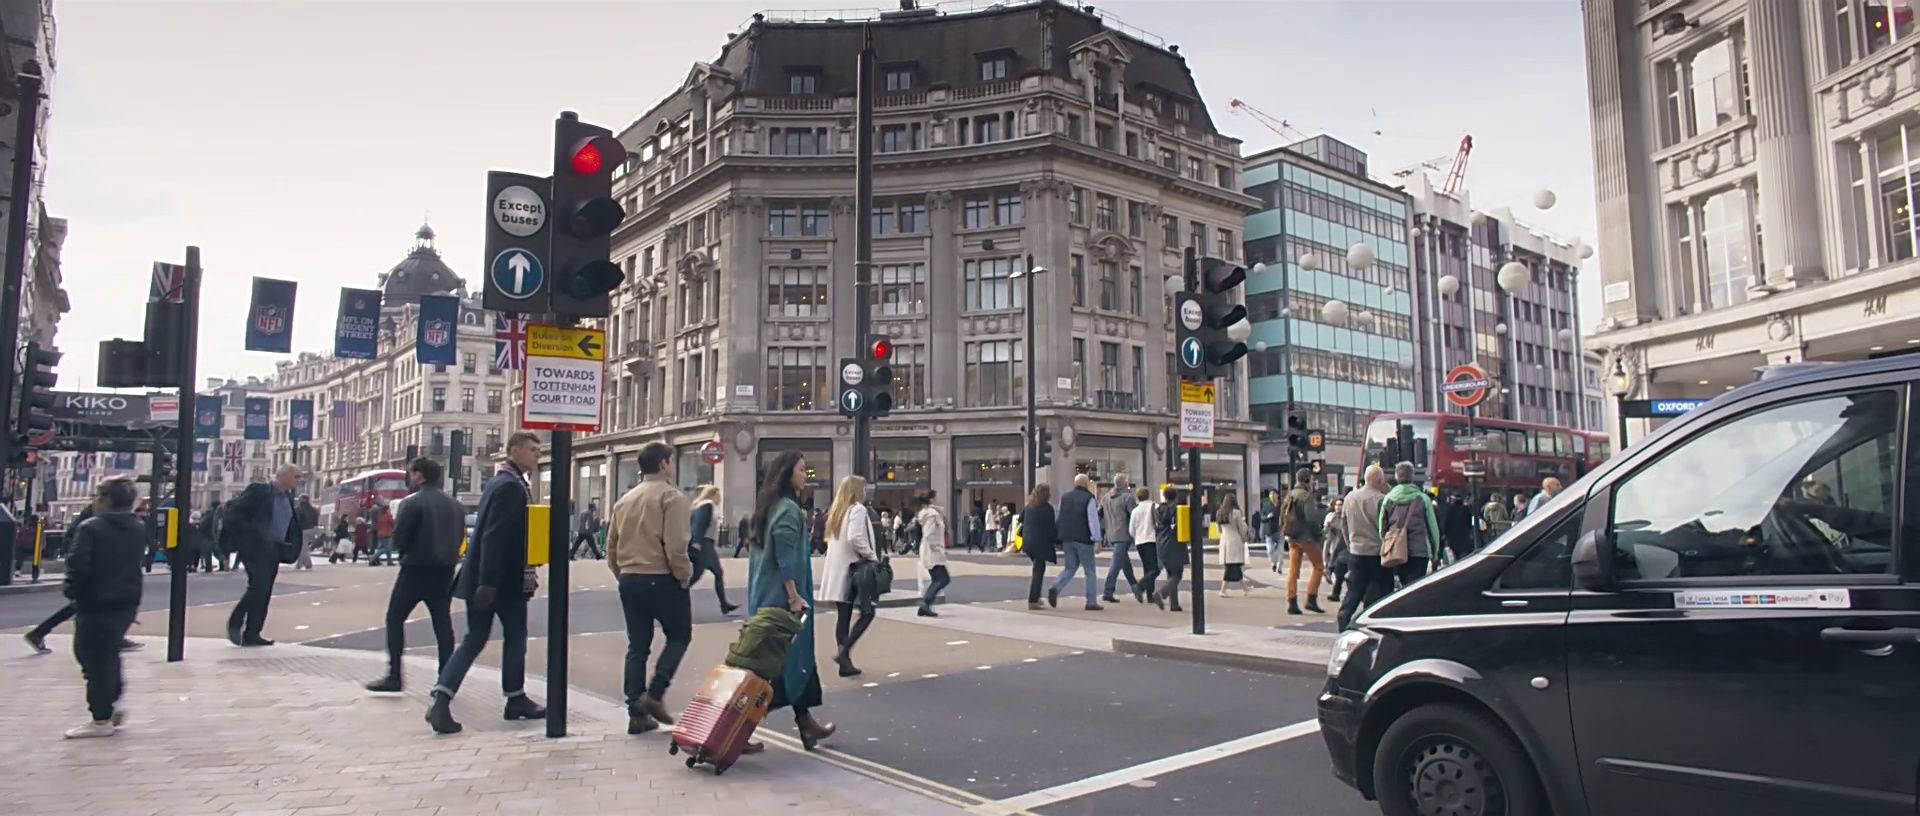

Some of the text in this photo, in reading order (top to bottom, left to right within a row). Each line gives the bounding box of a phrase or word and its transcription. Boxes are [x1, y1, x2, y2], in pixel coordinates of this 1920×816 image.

[499, 200, 542, 214] Except
[502, 212, 538, 226] buses
[258, 315, 281, 330] NFL
[342, 316, 374, 326] NFL ON
[340, 323, 376, 333] REGENT
[339, 331, 374, 340] STREET
[426, 330, 448, 343] NFL
[532, 341, 574, 352] Diversion
[534, 367, 595, 381] TOWARDS
[532, 381, 596, 393] TOTTENHAM
[1442, 381, 1488, 391] UNDERGROUND
[65, 395, 127, 410] KIKO
[531, 393, 596, 405] COURT ROAD
[1657, 402, 1696, 411] OXFORD
[1187, 424, 1209, 433] CIRCUS
[1828, 593, 1845, 603] Pay
